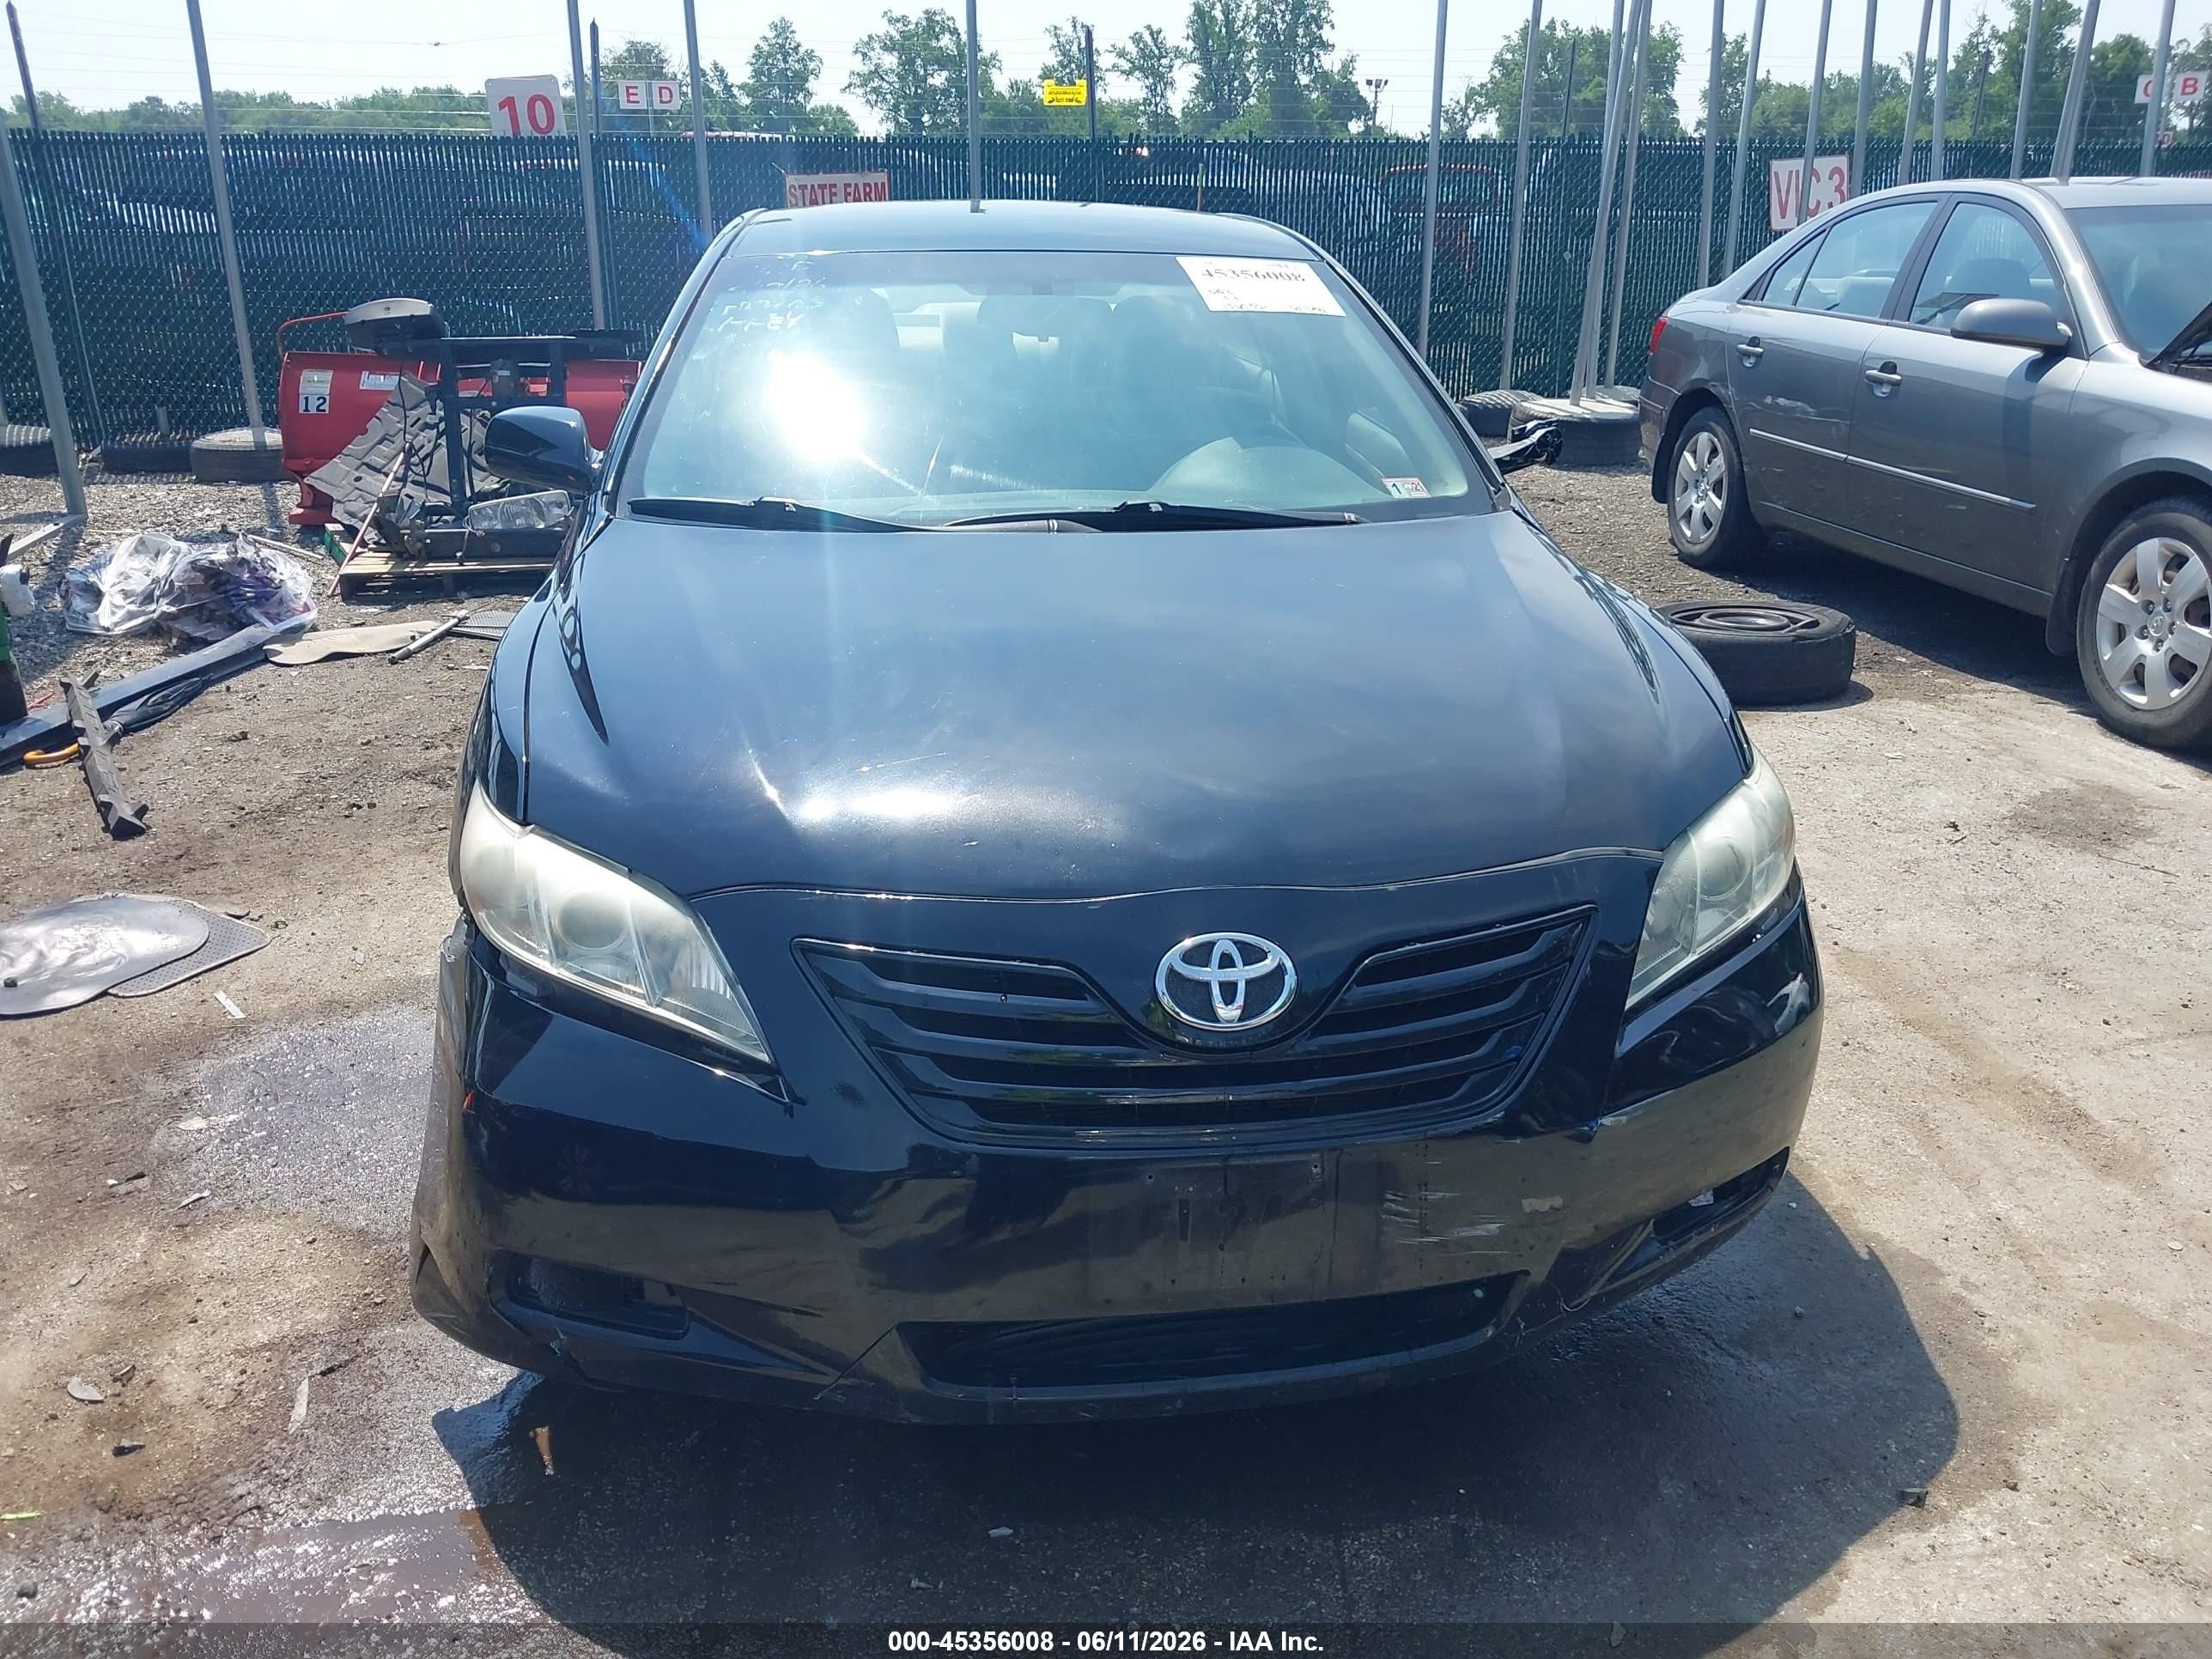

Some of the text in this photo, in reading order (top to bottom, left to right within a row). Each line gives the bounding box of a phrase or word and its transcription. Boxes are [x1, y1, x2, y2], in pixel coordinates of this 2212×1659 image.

[625, 85, 641, 104] E
[658, 86, 674, 105] D
[2181, 77, 2198, 96] B
[497, 94, 556, 136] 10
[788, 181, 886, 207] STATE FARM
[1826, 166, 1846, 209] 3
[302, 396, 327, 413] 12
